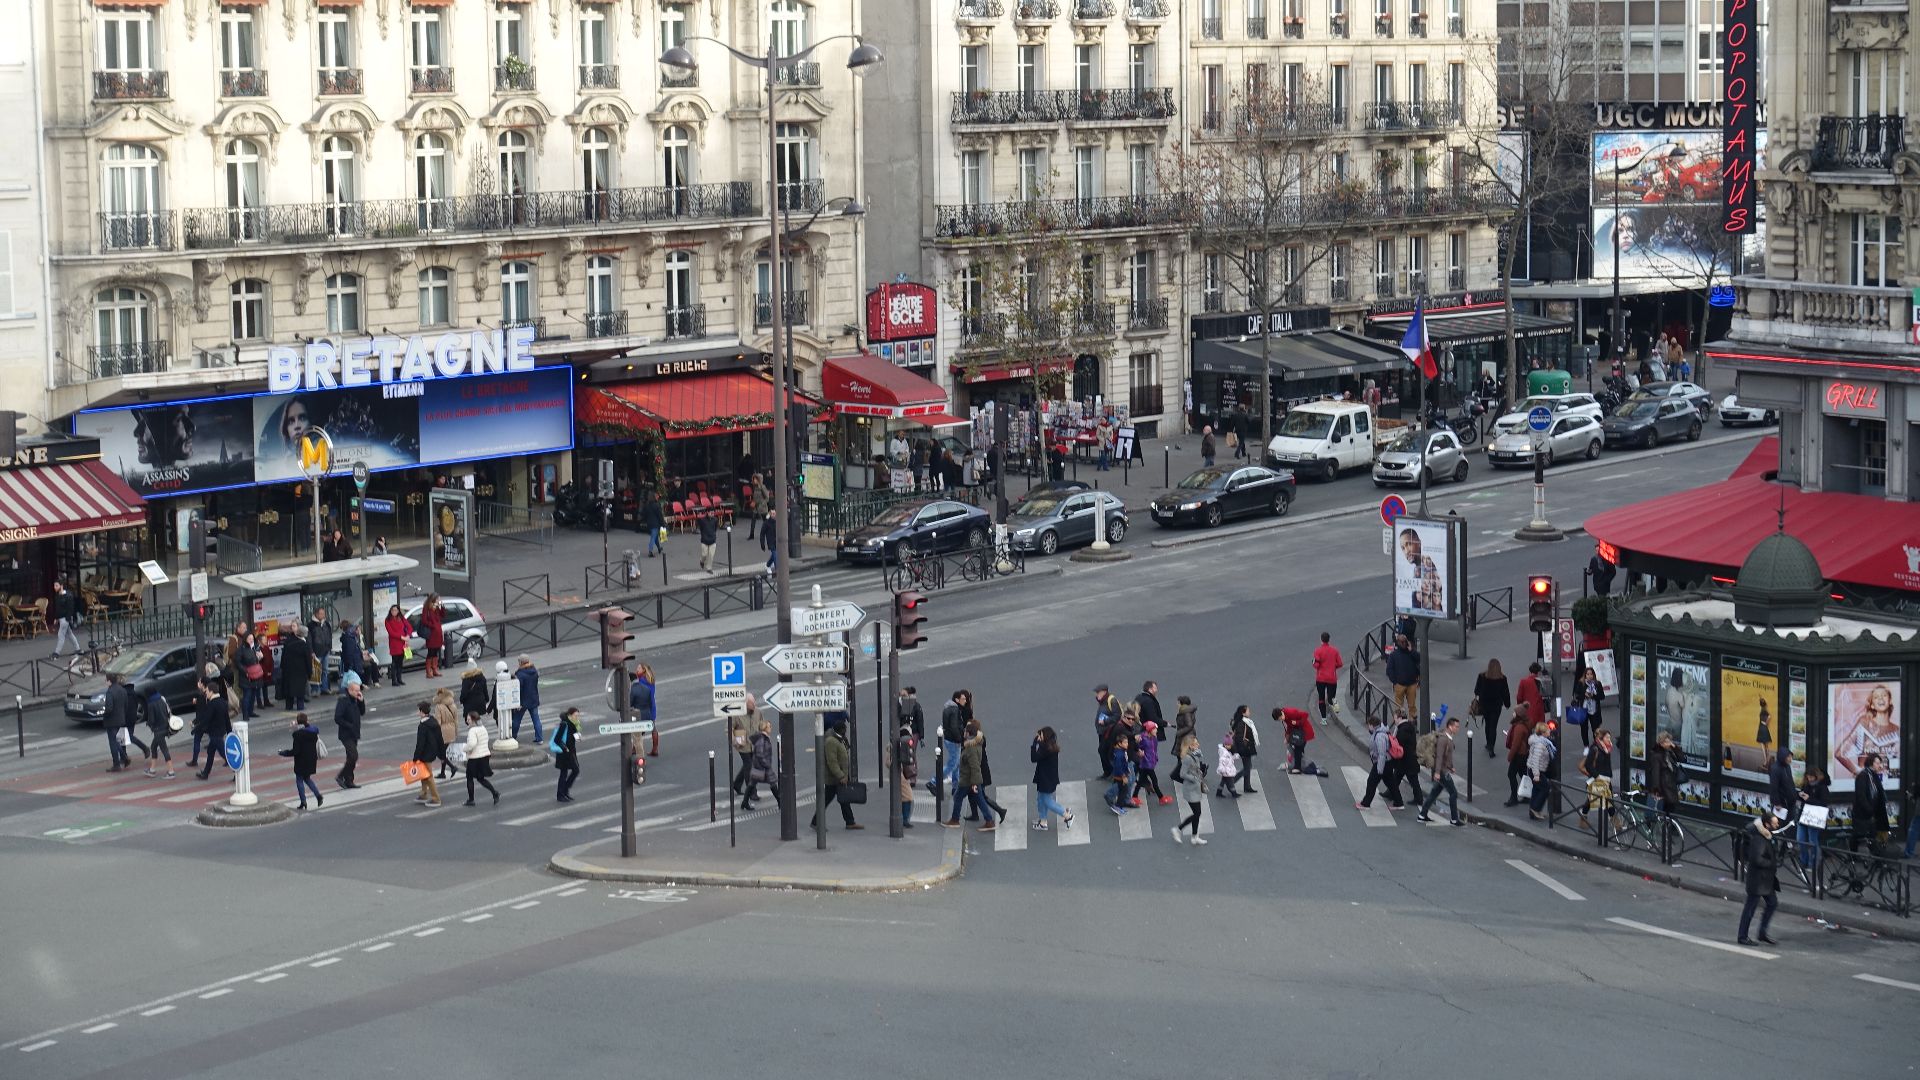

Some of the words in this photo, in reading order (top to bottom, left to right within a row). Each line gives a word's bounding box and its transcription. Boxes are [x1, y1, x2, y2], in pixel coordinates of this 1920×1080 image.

[1597, 104, 1655, 128] UGC
[889, 309, 923, 326] OCHE
[1247, 315, 1270, 335] CAF
[1272, 312, 1293, 332] ITALIA
[268, 327, 534, 394] BRETAGNE
[1826, 382, 1878, 410] GRILL
[354, 467, 366, 477] BUS
[809, 609, 846, 622] DENFERT
[804, 618, 851, 633] ROCHEREAU
[797, 650, 842, 659] GERMAIN
[721, 660, 736, 681] P
[789, 661, 808, 671] DES
[812, 660, 838, 669] PRÉS
[714, 690, 745, 699] RENNES
[792, 688, 843, 698] INVALIDES
